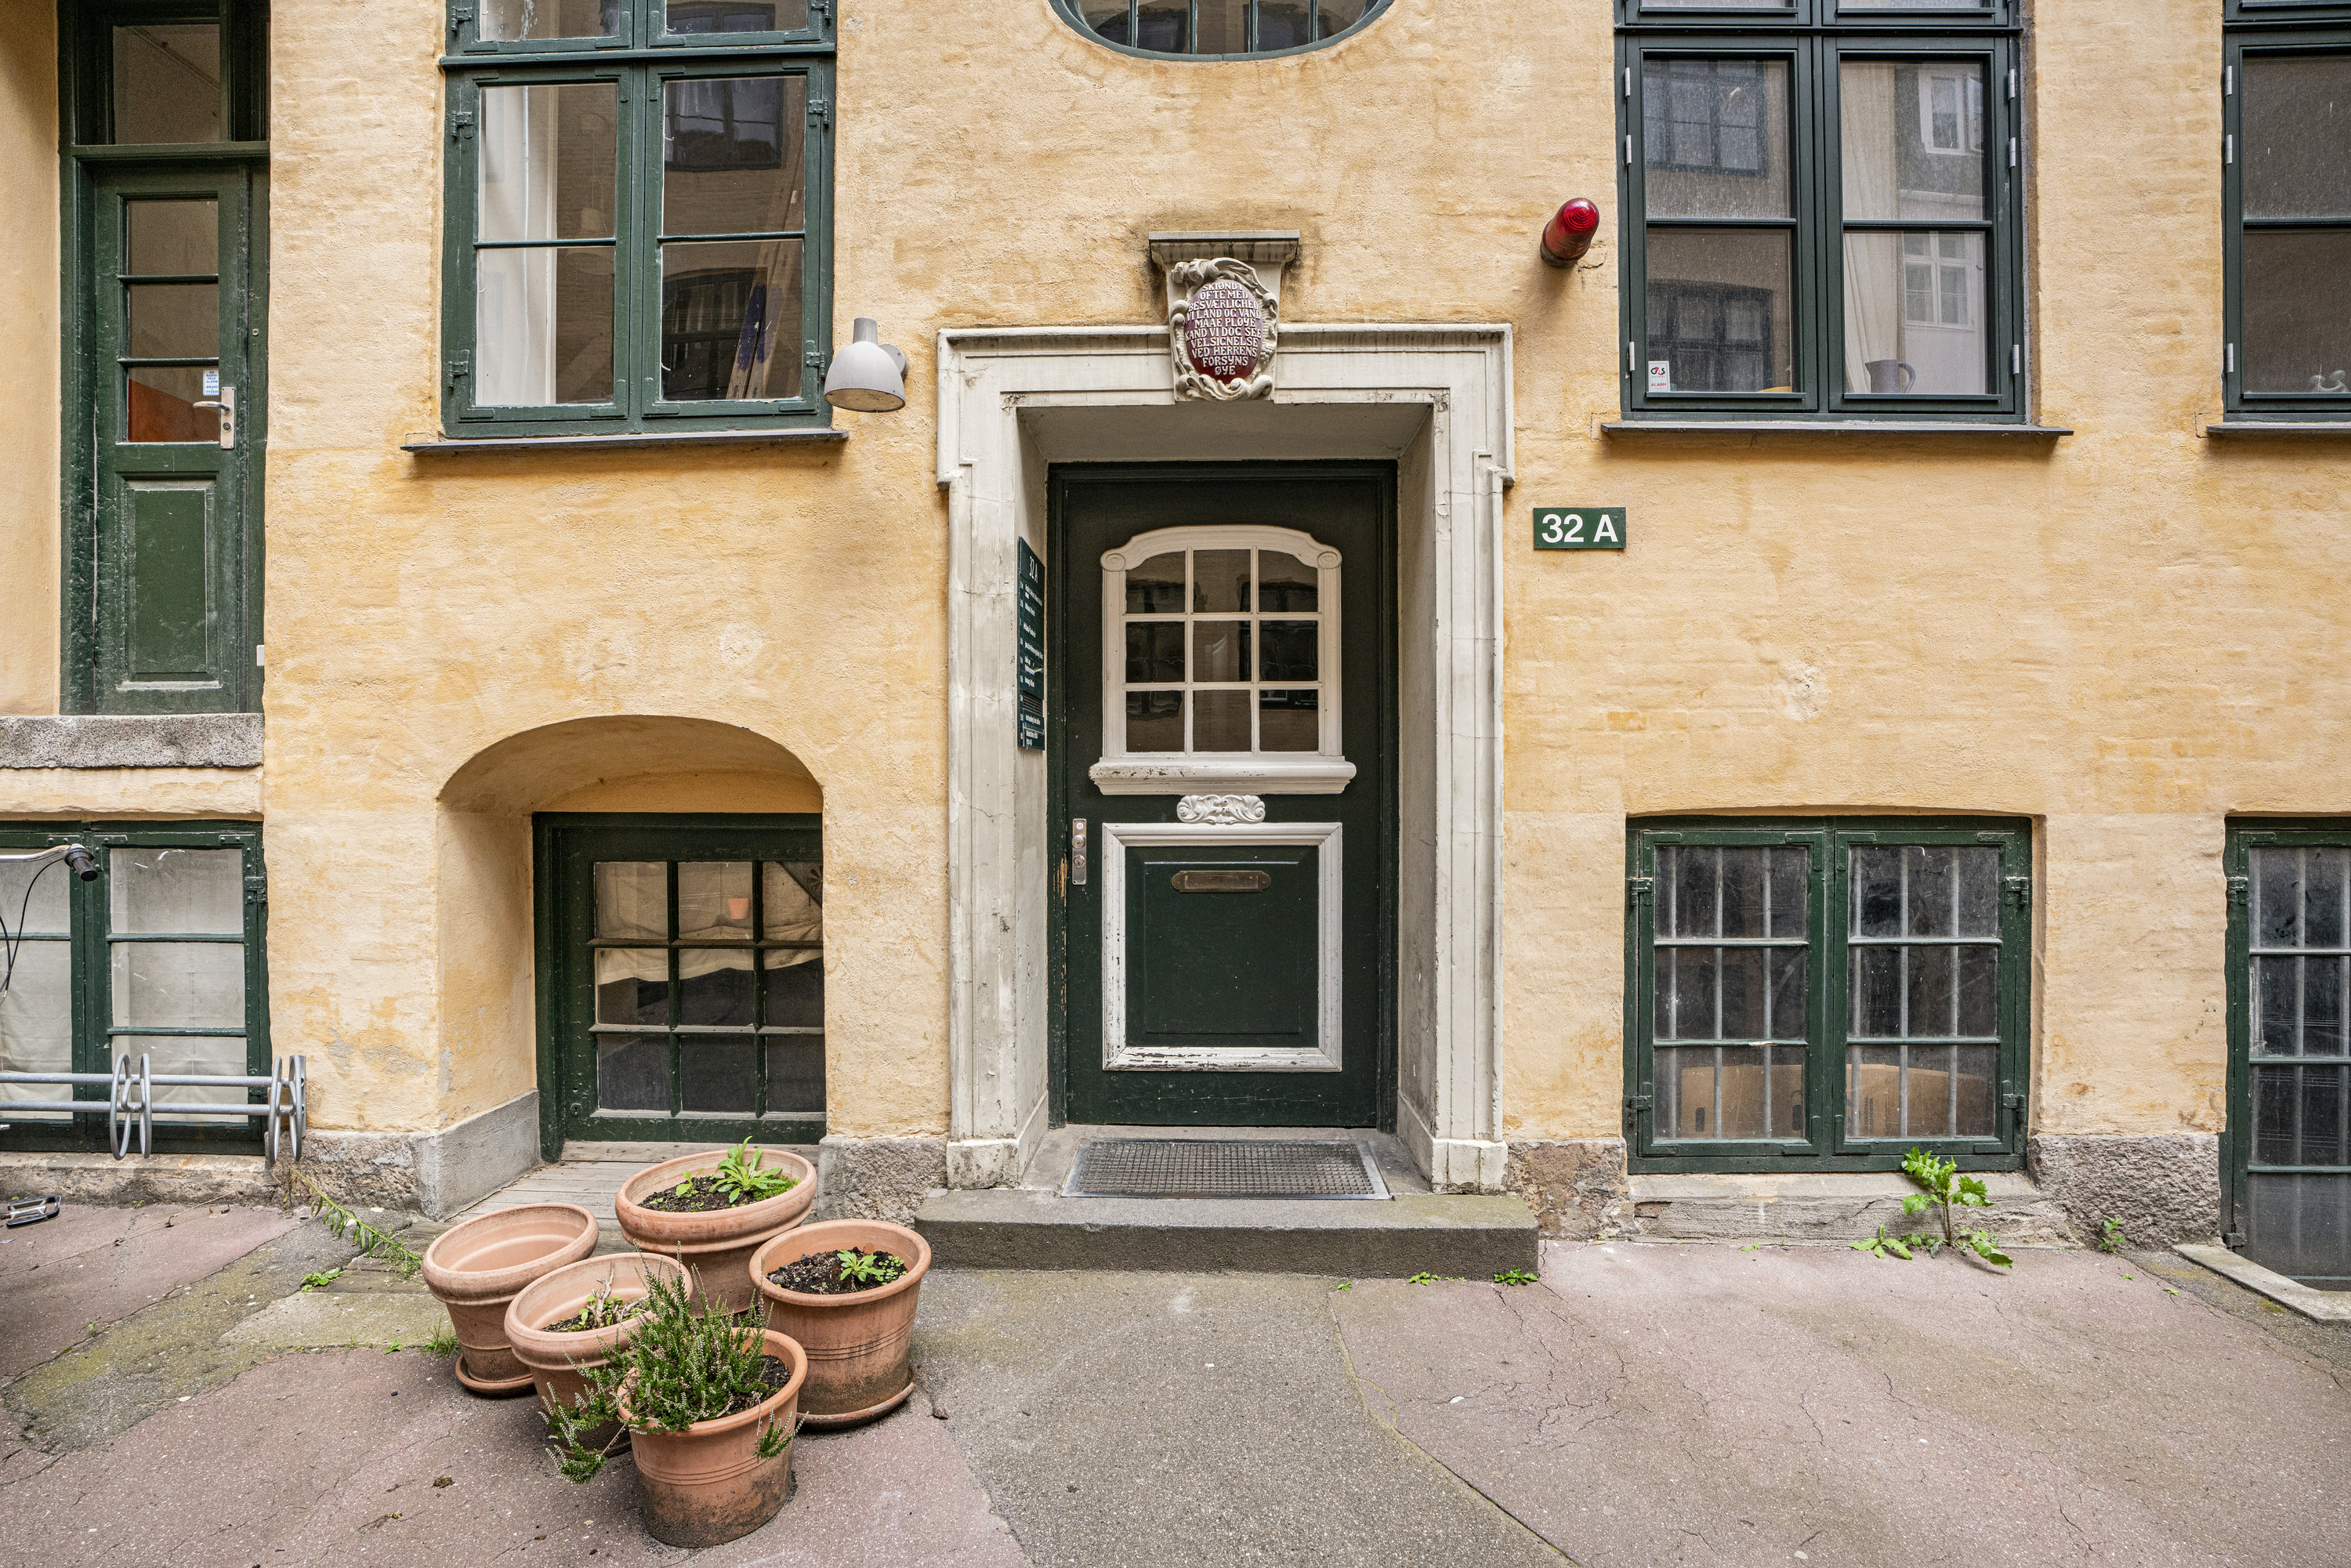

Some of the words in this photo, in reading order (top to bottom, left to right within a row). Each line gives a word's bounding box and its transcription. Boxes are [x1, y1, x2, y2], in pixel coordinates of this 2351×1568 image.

[1200, 291, 1226, 300] OFTE
[1227, 291, 1248, 299] MED
[1189, 299, 1258, 312] BESVÆRLIGHED
[1186, 311, 1194, 320] VI
[1197, 309, 1222, 319] LAND
[1239, 309, 1261, 319] VAND
[1195, 318, 1222, 328] MAAE
[1226, 318, 1255, 327] PLØYE
[1185, 328, 1207, 341] KAND
[1209, 328, 1219, 336] VI
[1245, 328, 1261, 338] SEE
[1191, 337, 1259, 348] VELSIGNELSE
[1192, 347, 1210, 358] VED
[1213, 346, 1257, 357] HERRENS
[1202, 355, 1248, 367] FORSYNS
[1215, 365, 1236, 375] ØYE
[1541, 513, 1584, 543] 32
[1593, 514, 1618, 541] A
[1030, 556, 1034, 579] 32
[1034, 563, 1038, 583] A
